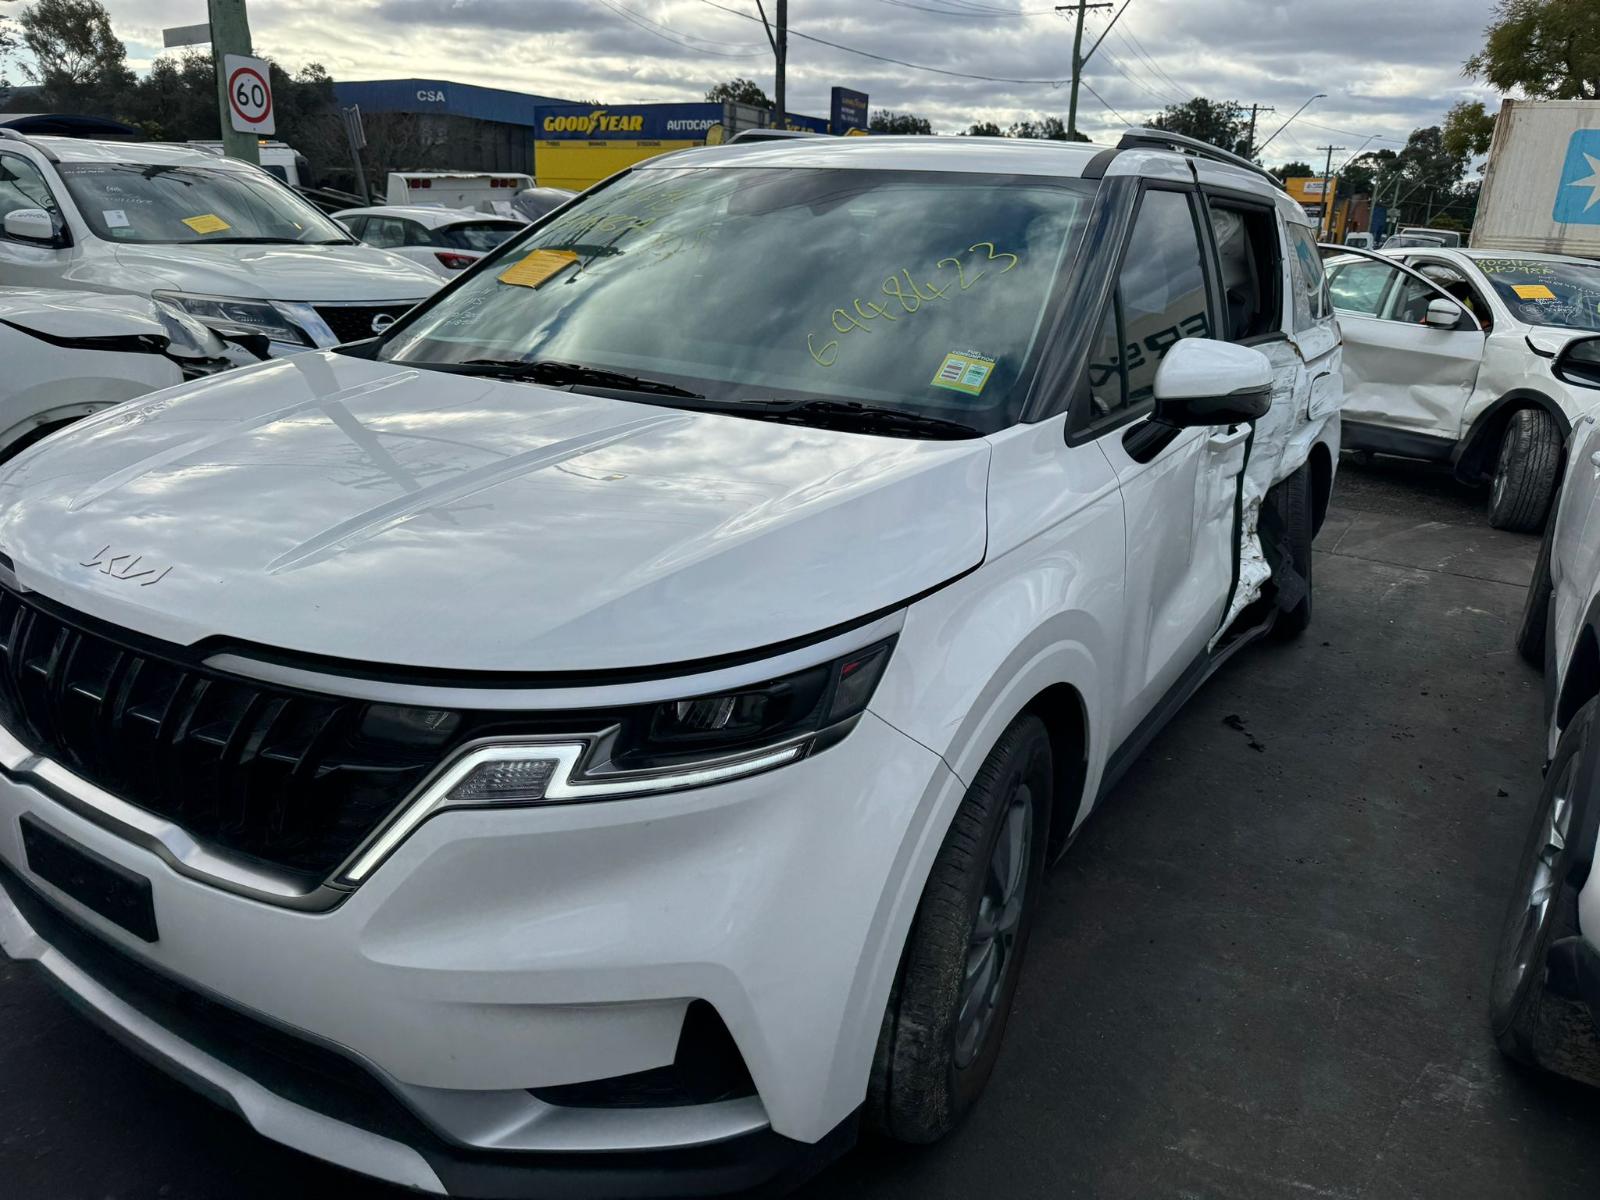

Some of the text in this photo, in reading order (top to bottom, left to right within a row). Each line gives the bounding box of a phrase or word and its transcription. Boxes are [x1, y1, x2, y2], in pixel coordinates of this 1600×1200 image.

[236, 82, 265, 108] 60
[416, 90, 446, 103] CSA
[543, 111, 644, 134] GOODYEAR
[79, 545, 173, 587] KIA
